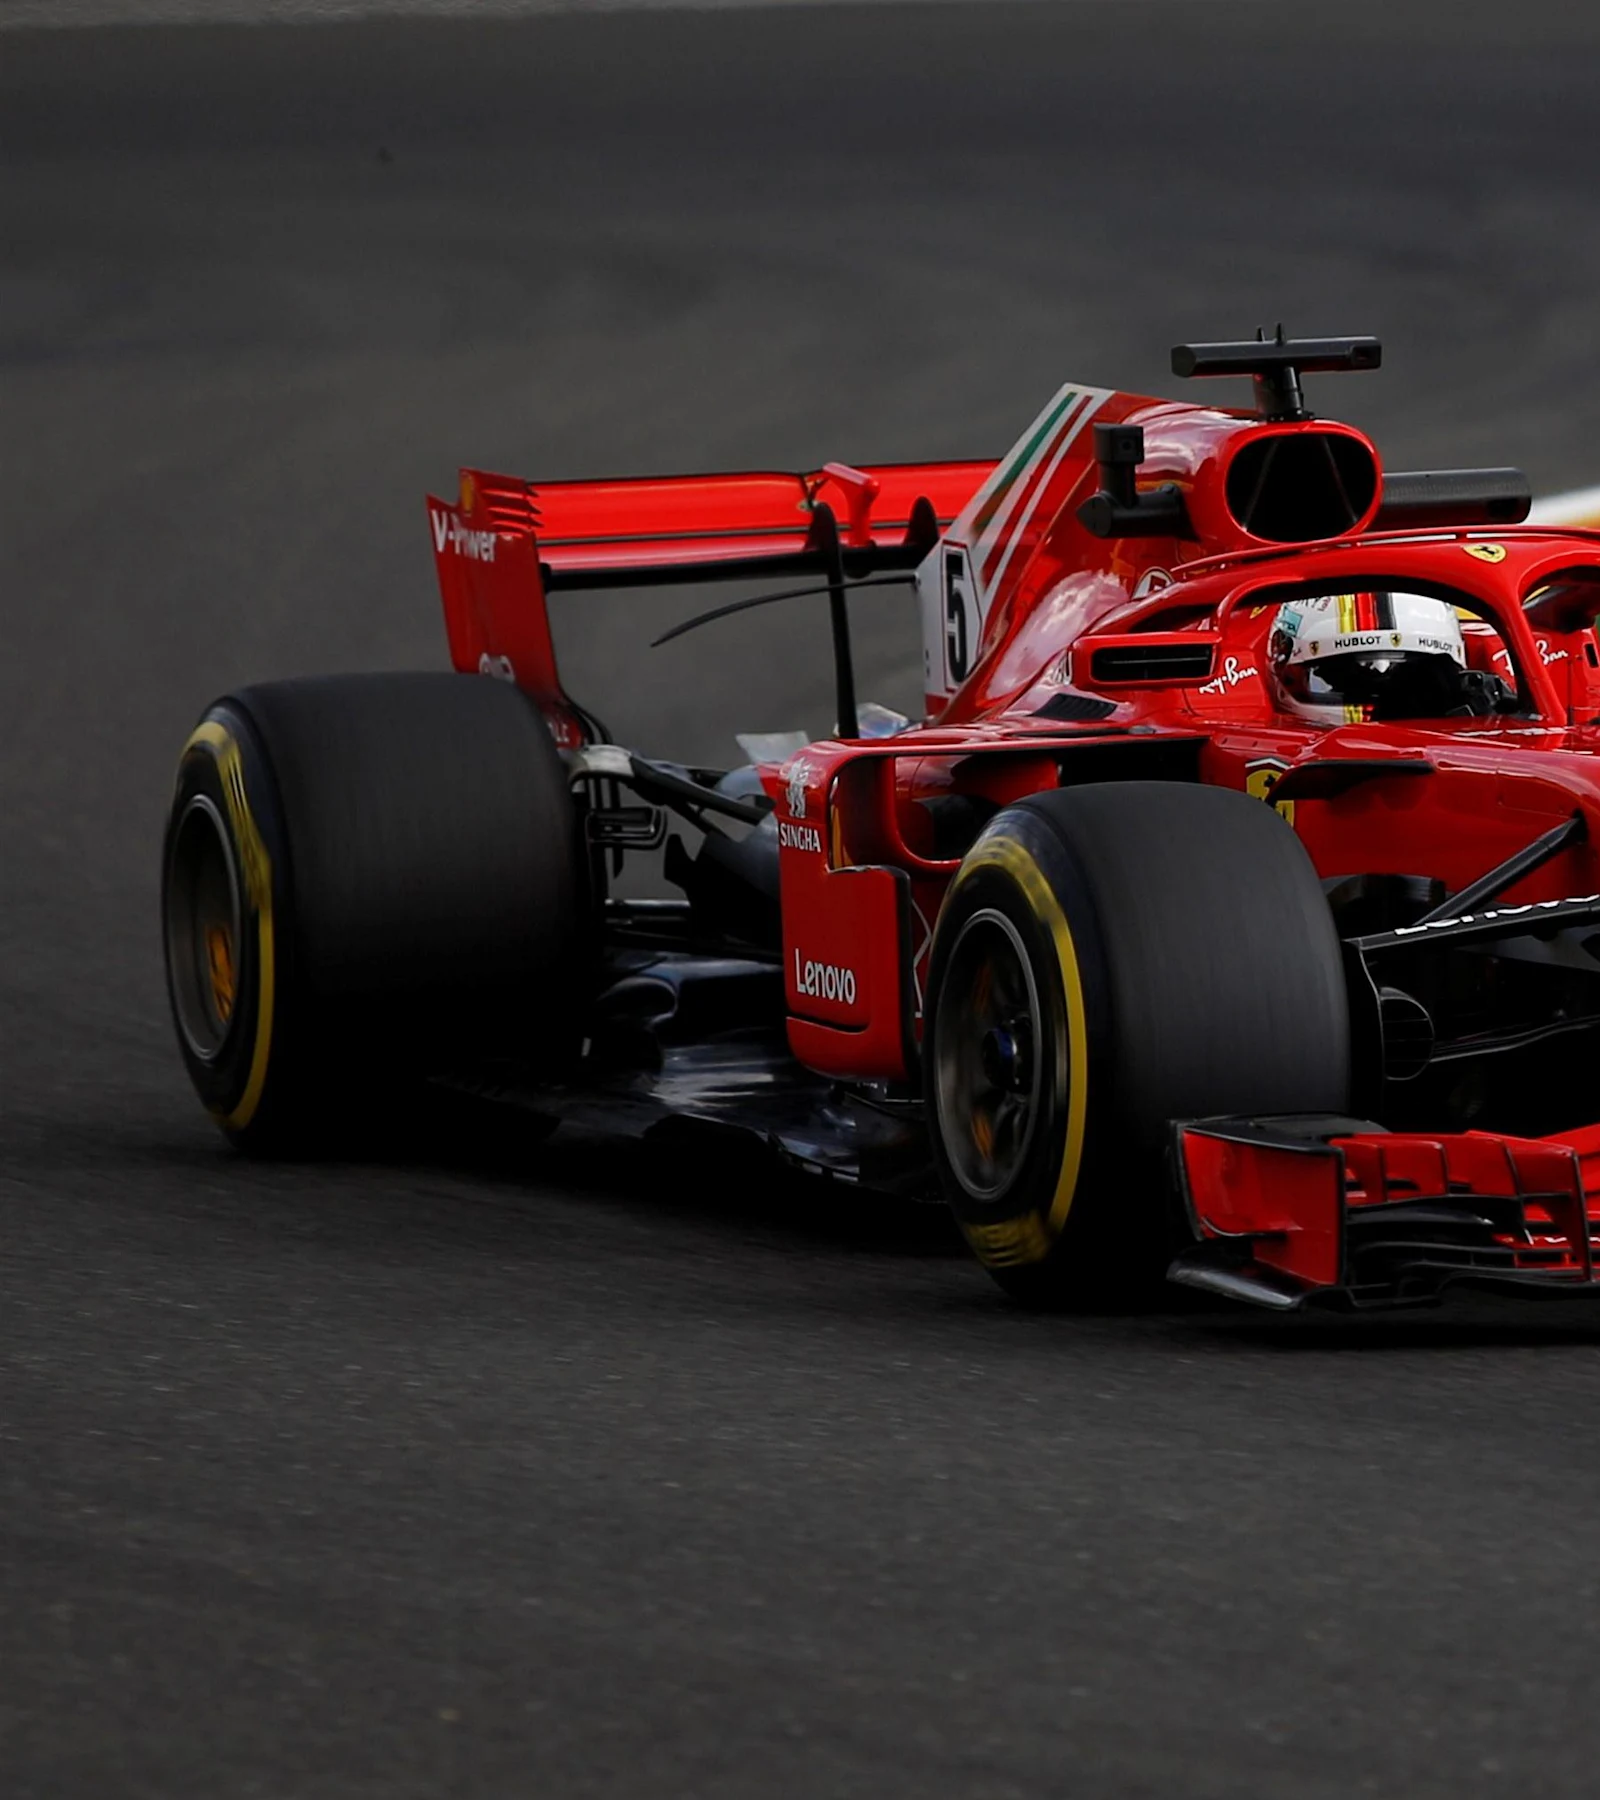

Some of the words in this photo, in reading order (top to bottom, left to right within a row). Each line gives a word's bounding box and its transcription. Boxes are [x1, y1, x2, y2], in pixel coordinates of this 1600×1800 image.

[945, 552, 968, 683] 5
[1334, 635, 1382, 649] HUBLOT
[1418, 637, 1453, 652] HUBLOT
[1199, 656, 1258, 694] Ray-Ban
[780, 822, 822, 853] SINGHA
[795, 947, 856, 1005] Lenovo
